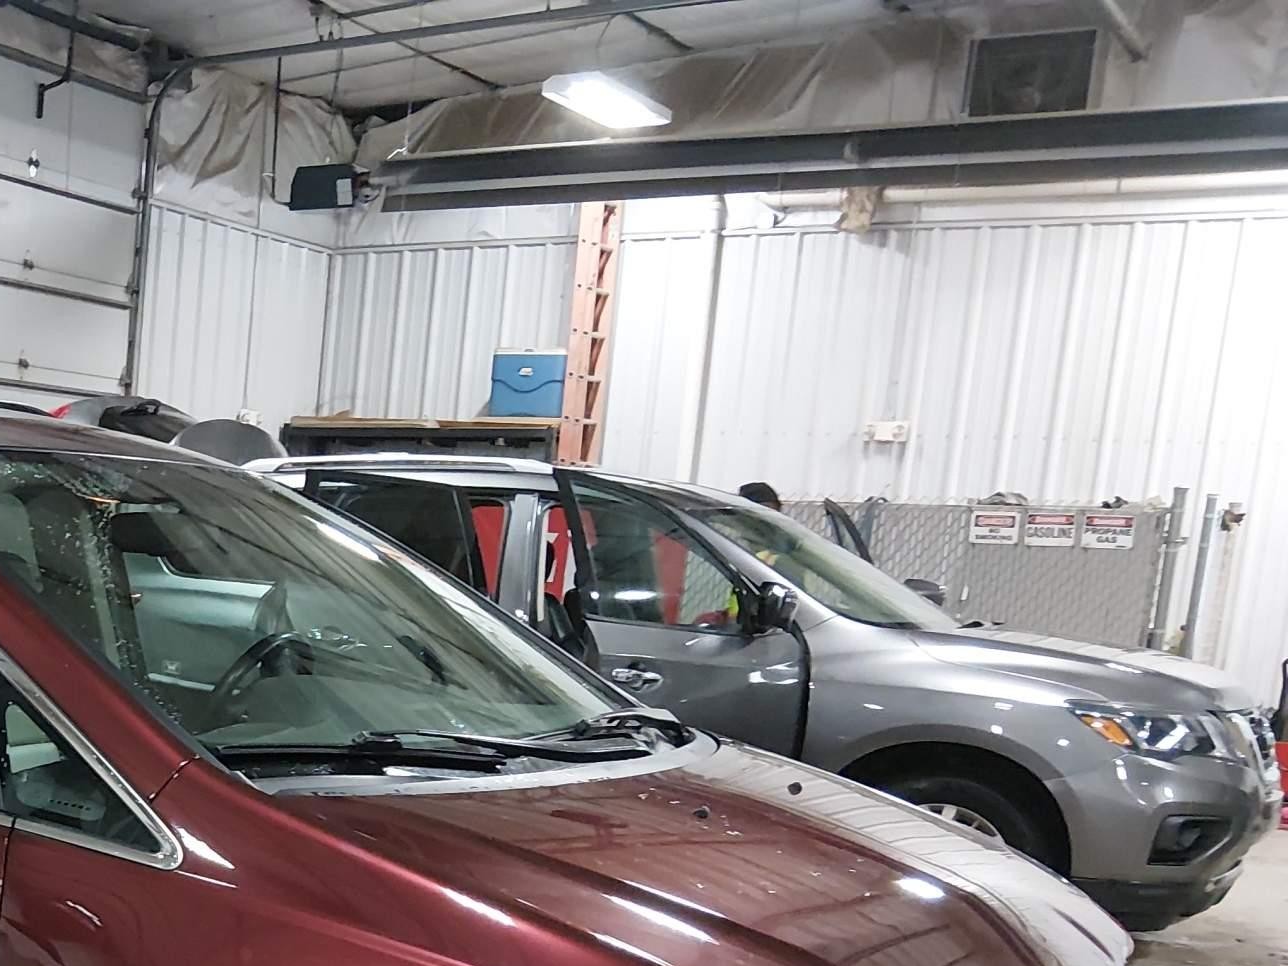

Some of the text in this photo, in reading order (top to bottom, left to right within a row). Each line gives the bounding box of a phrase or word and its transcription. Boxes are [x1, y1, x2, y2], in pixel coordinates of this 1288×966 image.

[1027, 526, 1073, 539] GASOLINE
[1084, 527, 1132, 536] PROPANE
[1095, 535, 1117, 543] GAS
